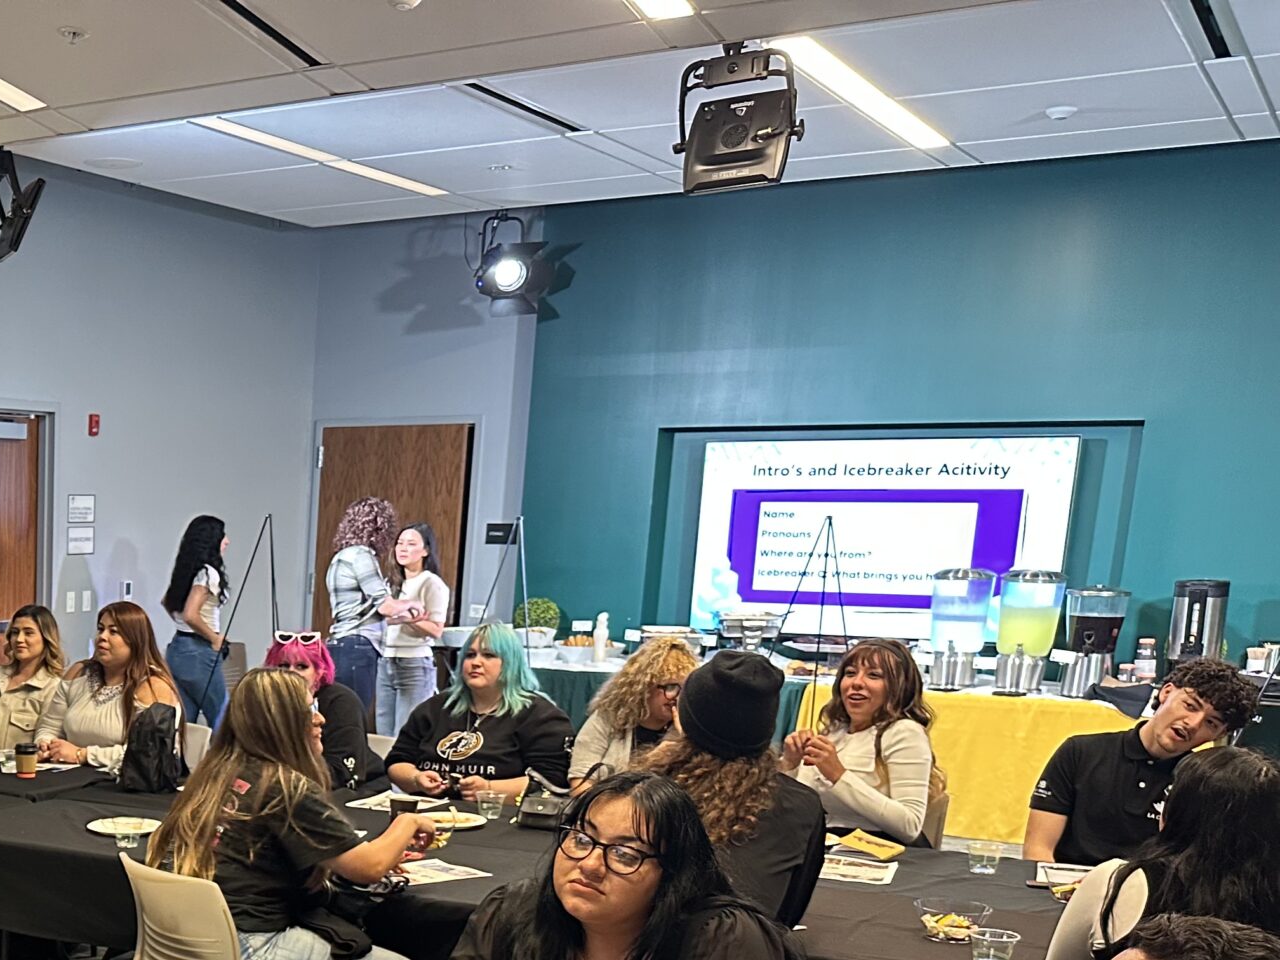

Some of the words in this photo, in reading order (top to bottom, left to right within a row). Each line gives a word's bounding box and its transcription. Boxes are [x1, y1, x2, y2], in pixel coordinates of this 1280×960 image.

[752, 464, 803, 477] Intro's
[808, 463, 838, 477] and
[843, 462, 933, 476] Icebreaker
[937, 462, 1011, 480] Acitivity
[763, 510, 796, 519] Name
[761, 529, 812, 539] Pronouns
[760, 549, 794, 558] Where
[839, 550, 872, 559] from?
[757, 568, 815, 578] Icebreaker
[831, 570, 860, 579] What
[863, 571, 898, 582] brings
[902, 572, 923, 582] you
[418, 761, 450, 772] JOHN
[455, 764, 496, 775] MUIR
